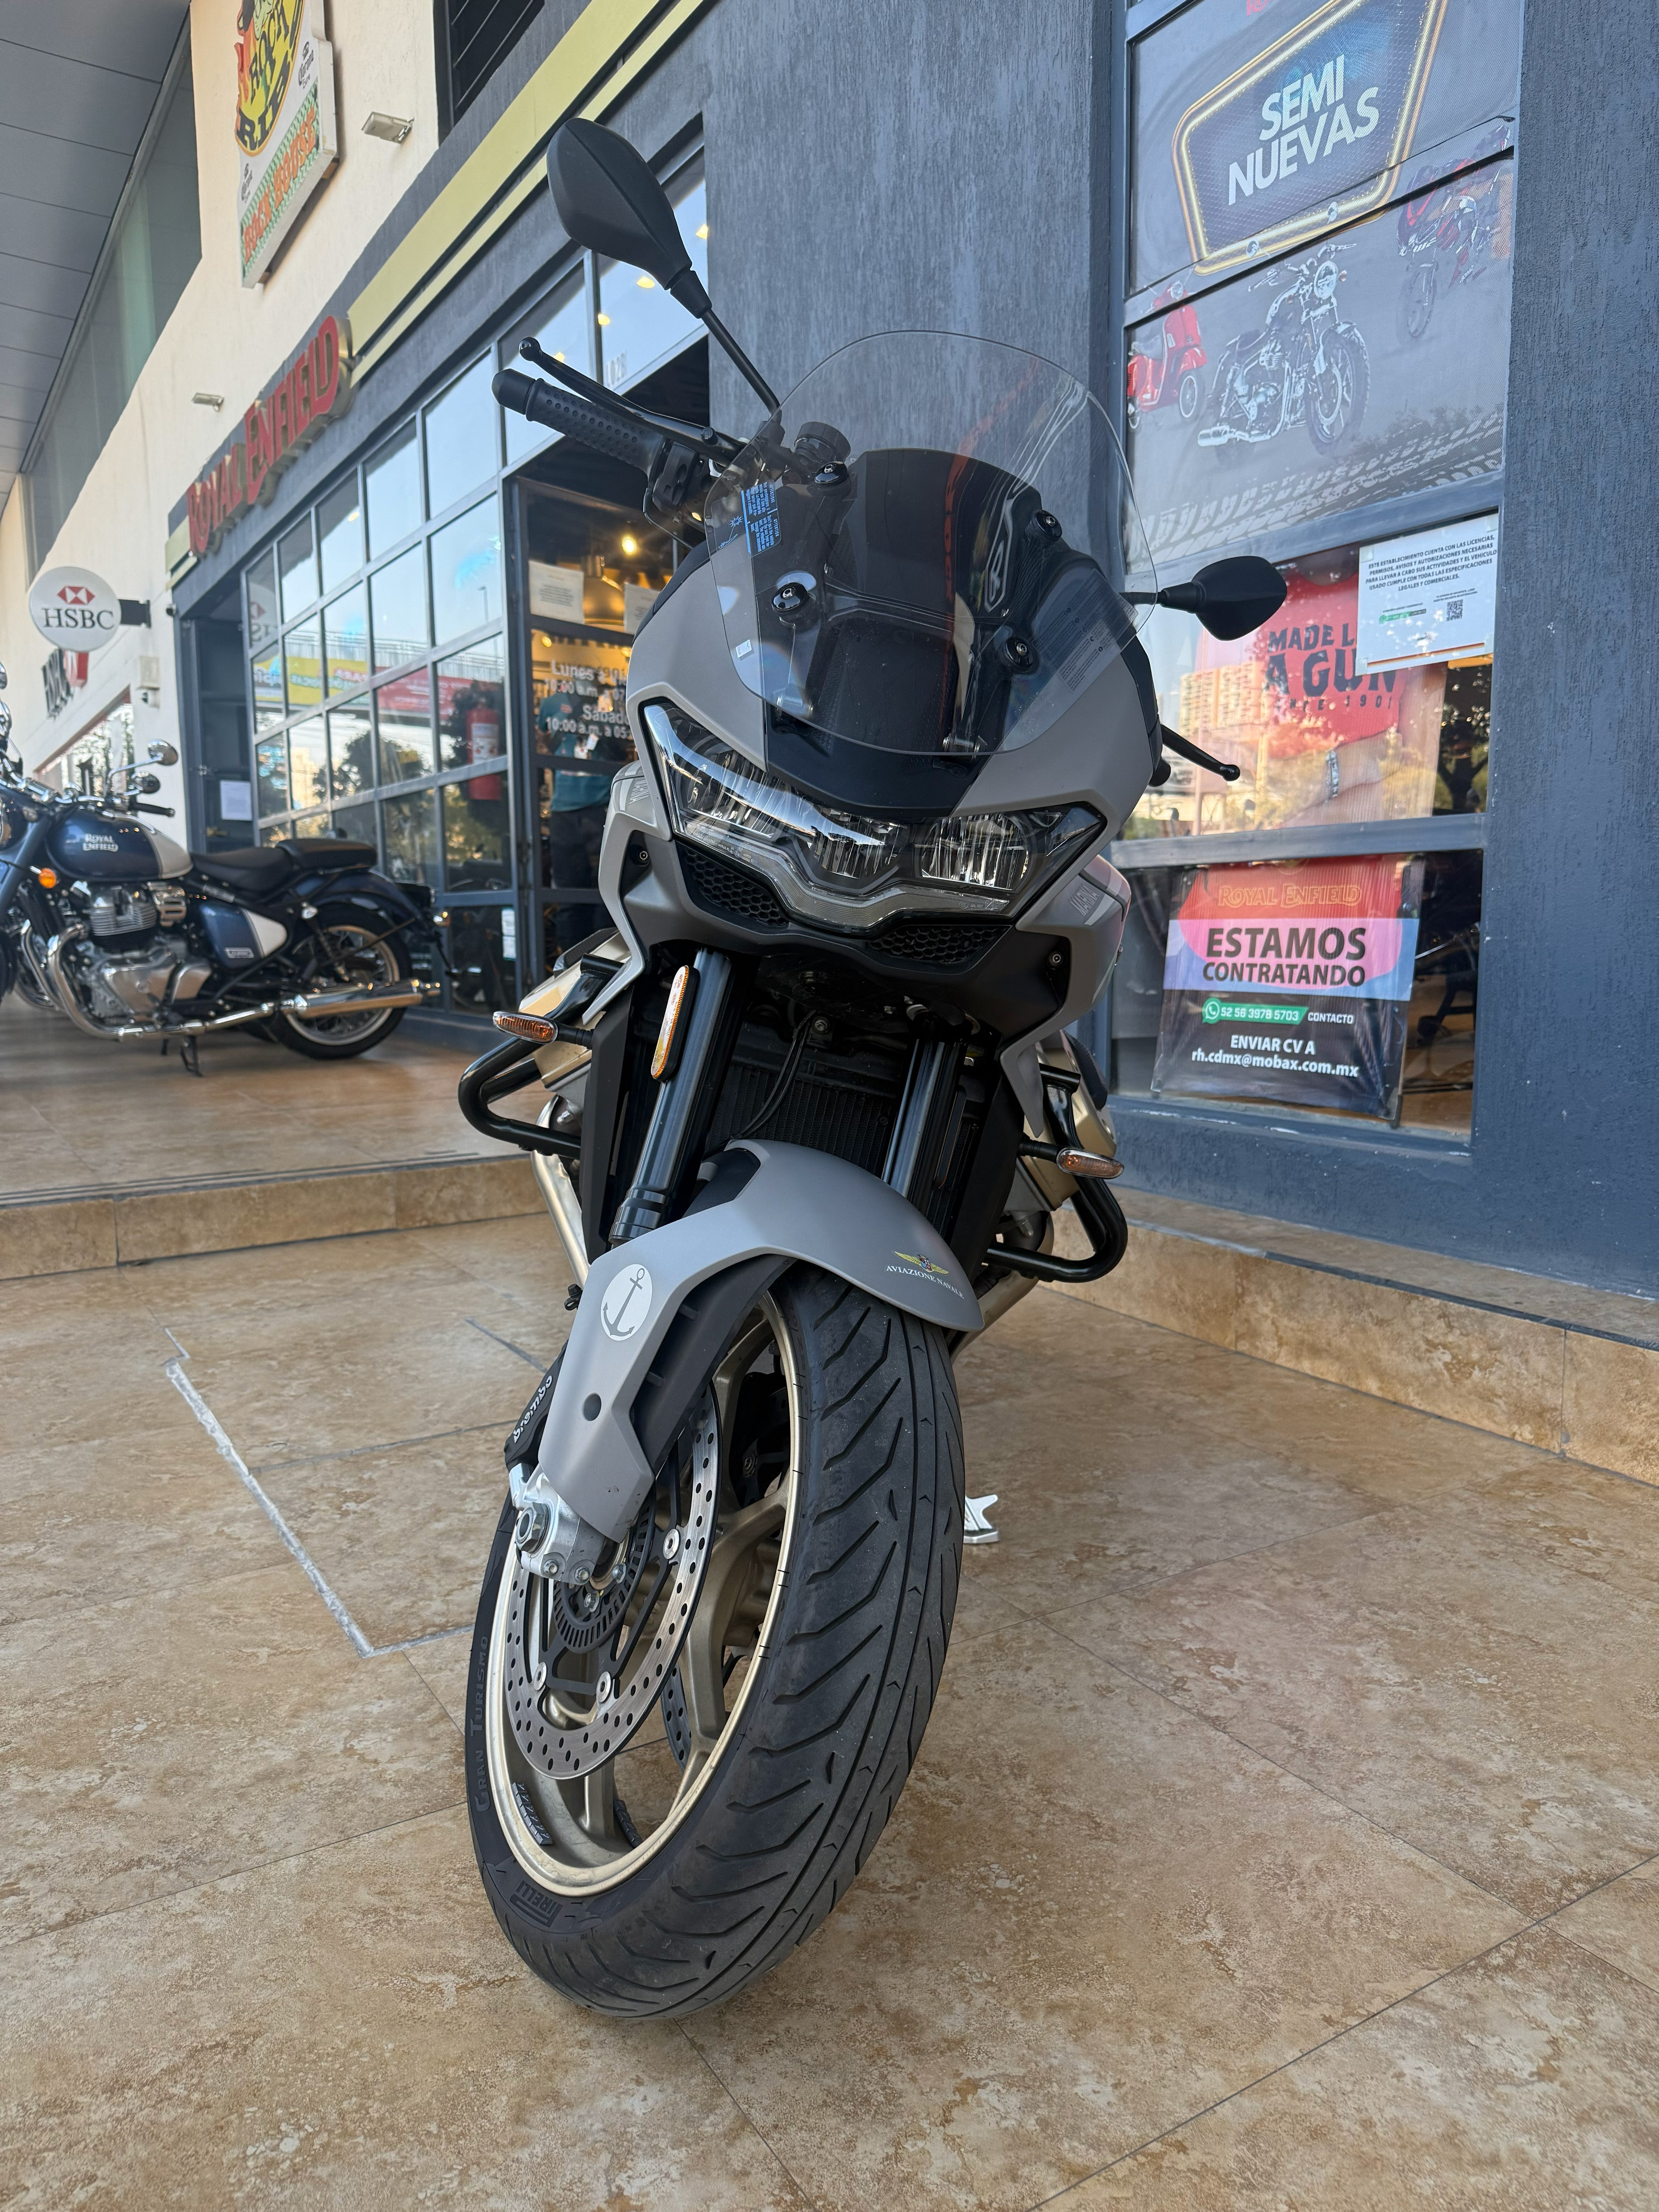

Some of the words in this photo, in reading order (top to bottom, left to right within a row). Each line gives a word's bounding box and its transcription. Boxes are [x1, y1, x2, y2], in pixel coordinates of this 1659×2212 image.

[1259, 54, 1345, 140] SEMI
[1228, 87, 1379, 206] NUEVAS
[244, 184, 271, 265] ROCK
[273, 105, 316, 211] HOUSE
[186, 445, 242, 553] ROYAL
[244, 315, 339, 504] ENFIELD
[1379, 573, 1396, 581] LLEVAR
[1426, 558, 1459, 571] ACTIVIDADES
[1381, 552, 1423, 566] ESTABLECIMIENTO
[1425, 547, 1444, 556] CUENTA
[1395, 562, 1412, 570] AVISOS
[1418, 550, 1460, 564] AUTORIZACIONES
[1462, 543, 1493, 555] NECESARIAS
[1369, 582, 1386, 590] USADO
[1387, 578, 1406, 586] CUMPLE
[1418, 571, 1434, 579] TODAS
[1445, 558, 1492, 574] ESPECIFICACIONES
[1398, 582, 1419, 591] LEGALES
[41, 607, 115, 630] HSBC
[1267, 624, 1334, 653] MADE
[551, 659, 594, 680] Lunes
[1265, 653, 1290, 695] A
[546, 717, 576, 732] 10:00
[605, 725, 612, 736] a
[83, 843, 118, 852] ENFIELD
[85, 833, 115, 843] ROYAL
[1070, 885, 1099, 917] MARINA
[1218, 885, 1277, 908] ROYAL
[1280, 883, 1361, 908] ENFIELD
[1206, 927, 1366, 961] ESTAMOS
[1203, 962, 1365, 987] CONTRATANDO
[1221, 1007, 1231, 1017] 52
[1234, 1007, 1245, 1018] 56
[1248, 1008, 1272, 1019] 3978
[1274, 1010, 1298, 1021] 5703
[1308, 1012, 1354, 1024] CONTACTO
[1230, 1034, 1280, 1052] ENVIAR
[1283, 1039, 1304, 1053] CV
[1305, 1041, 1316, 1055] A
[1192, 1048, 1359, 1078] rh.cdmx@mobax.com.mx
[886, 1266, 936, 1282] AVIAZIONE
[936, 1278, 964, 1299] NAVALE
[513, 1375, 553, 1444] brembo
[470, 1635, 488, 1737] TURISMO
[476, 1749, 491, 1812] GRAN
[510, 1879, 563, 1928] PIRELLI
